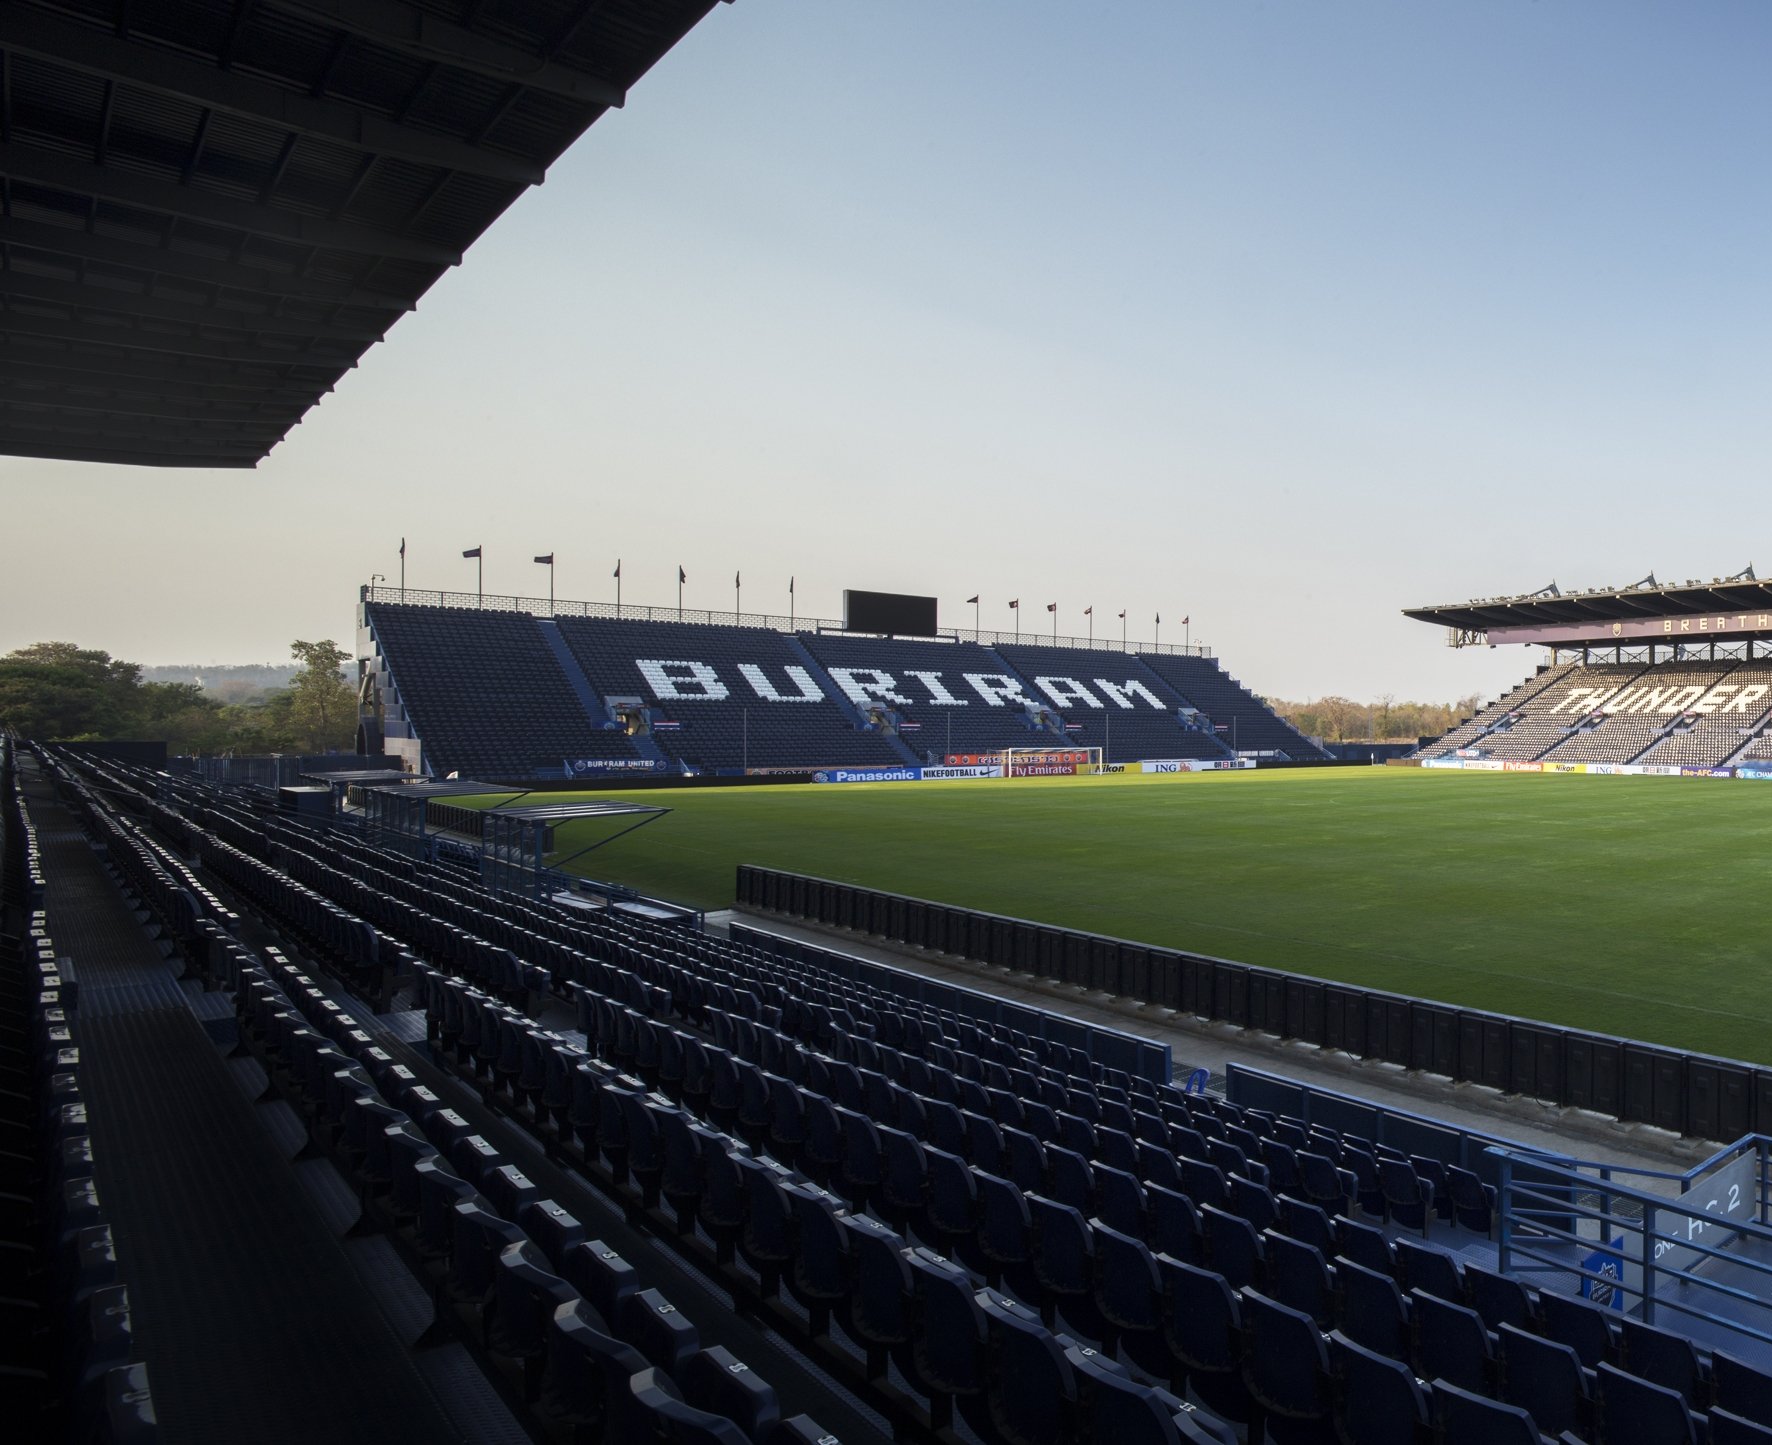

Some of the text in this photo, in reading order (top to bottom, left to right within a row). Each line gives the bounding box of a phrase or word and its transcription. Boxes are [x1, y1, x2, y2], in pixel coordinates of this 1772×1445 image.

[1663, 614, 1768, 633] BREATH
[635, 659, 1167, 710] BURIRAM
[1551, 684, 1769, 714] THUNDER
[923, 768, 977, 778] NIKEFOOTBALL
[1010, 765, 1073, 777] Fly Emirates
[1095, 764, 1125, 773] Nikon
[1155, 764, 1177, 773] ING
[1555, 764, 1575, 772] Nikon
[1596, 766, 1612, 775] ING
[1682, 769, 1730, 777] the-AFC.com
[836, 769, 915, 782] Panasonic
[1727, 1183, 1740, 1213] 2
